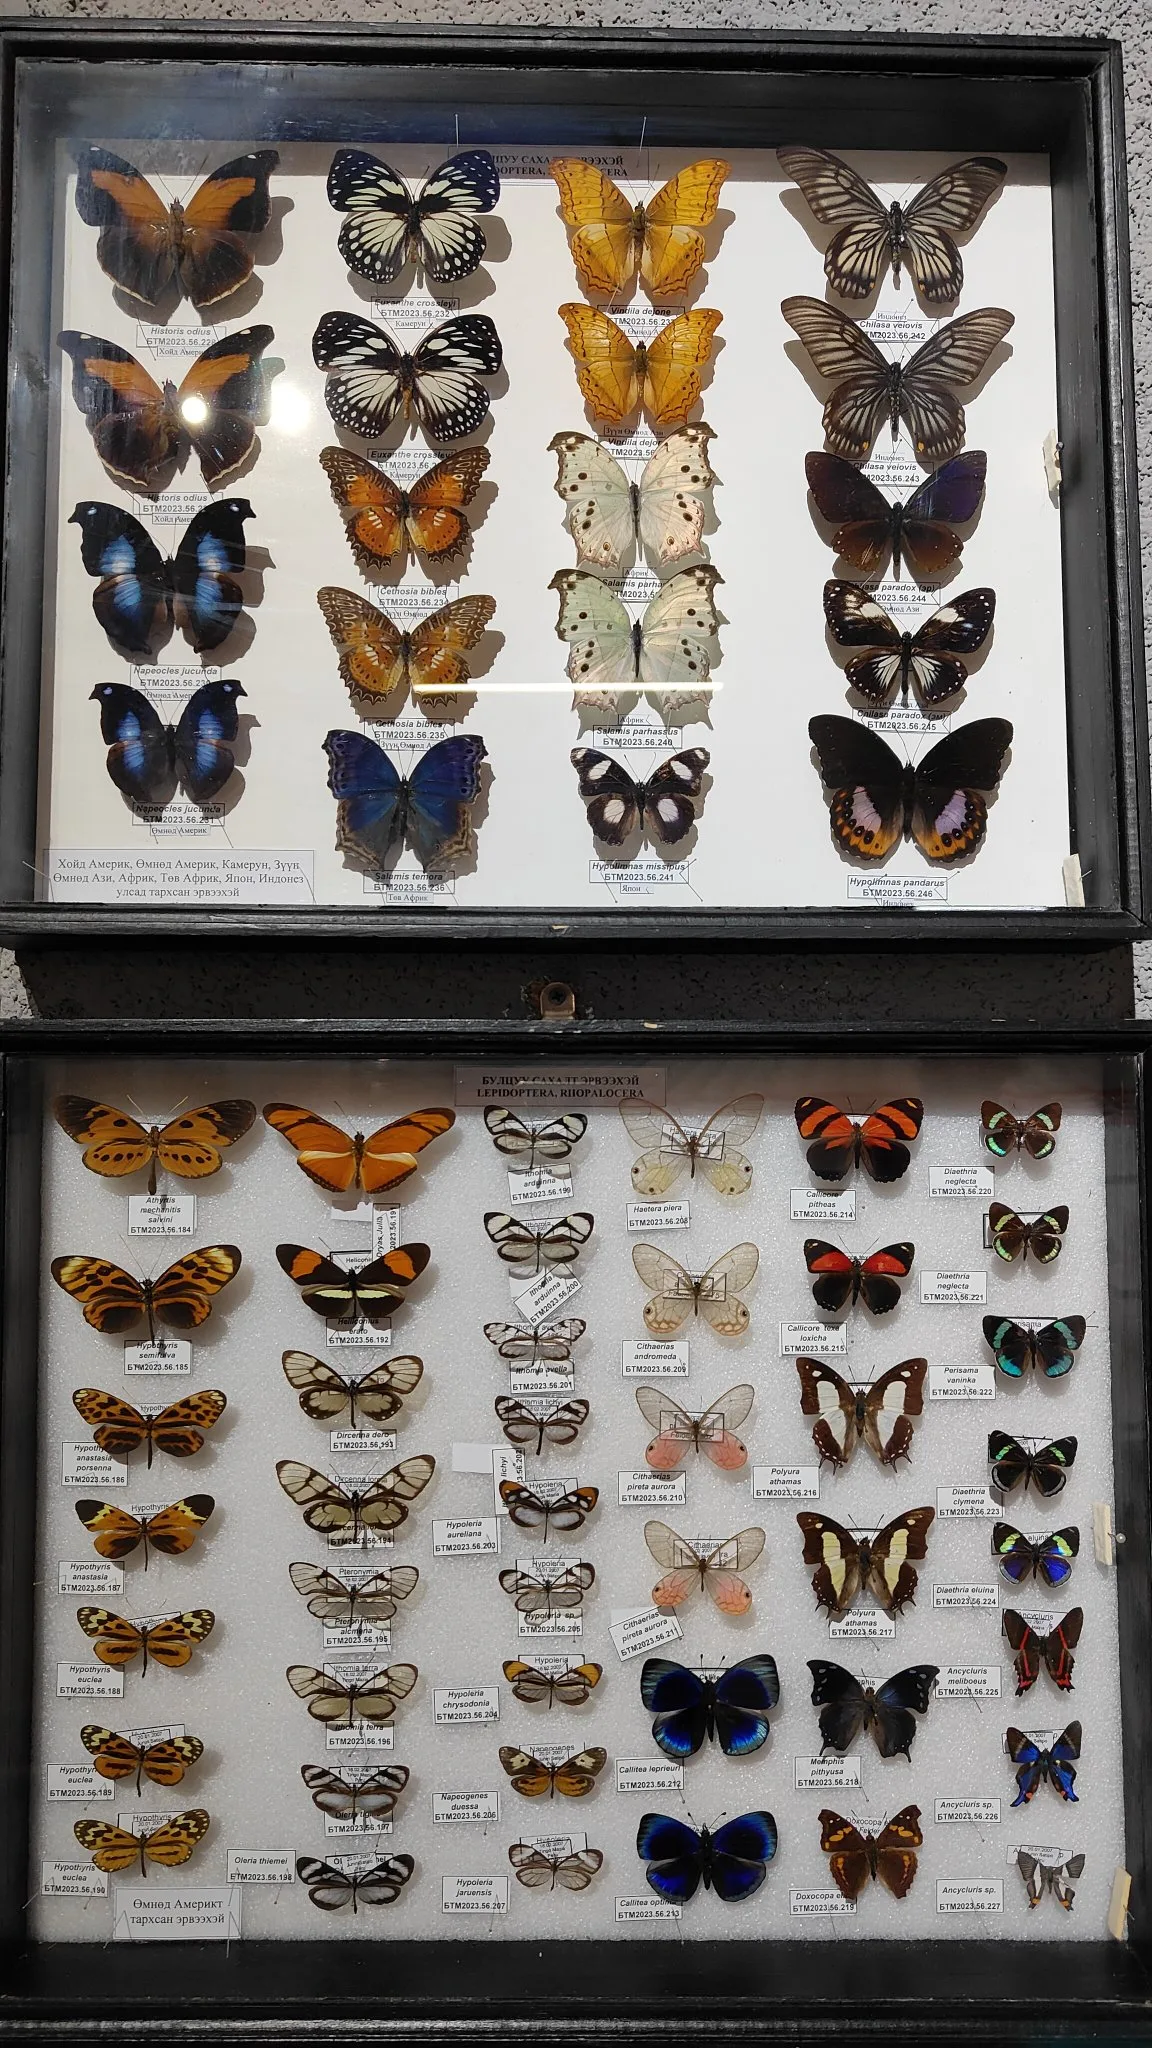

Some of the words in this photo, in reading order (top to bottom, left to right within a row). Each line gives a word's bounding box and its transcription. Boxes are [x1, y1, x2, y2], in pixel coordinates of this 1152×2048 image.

[859, 320, 891, 329] Chilasa
[181, 667, 217, 676] jucunda
[633, 728, 678, 737] parhassus
[135, 805, 182, 814] Napeocles
[58, 859, 86, 869] Хойд
[89, 859, 133, 870] Америк,
[136, 859, 173, 869] Өмнөд
[175, 859, 219, 870] Америк,
[222, 860, 271, 871] Камерун,
[274, 860, 300, 871] Зүүн
[53, 872, 89, 883] Өмнөд
[92, 873, 115, 883] Ази,
[118, 873, 158, 885] Африк,
[162, 873, 181, 883] Төв
[183, 873, 222, 885] Африк,
[225, 874, 257, 884] Япон,
[259, 873, 304, 884] Индонез
[375, 872, 409, 881] Salamis
[850, 877, 901, 887] Hypolimnas
[117, 888, 146, 898] улсад
[149, 888, 191, 898] тархсан
[194, 887, 240, 898] эрвээхэй
[580, 1075, 639, 1085] ЭРВЭЭХЭЙ
[477, 1088, 558, 1098] LEPIDOPTERA,
[560, 1089, 644, 1098] RHOPALOCERA
[534, 1281, 561, 1307] arduinna
[447, 1530, 482, 1539] aureliana
[622, 1611, 660, 1631] Cithaerias
[644, 1619, 668, 1635] aurora
[443, 1700, 490, 1709] chrysodonia
[811, 1768, 844, 1777] pithyusa
[54, 1863, 96, 1872] Hypothyris
[133, 1899, 171, 1909] Өмнөд
[174, 1899, 223, 1911] Америкт
[130, 1916, 173, 1926] тархсан
[176, 1913, 225, 1926] эрвээхэй
